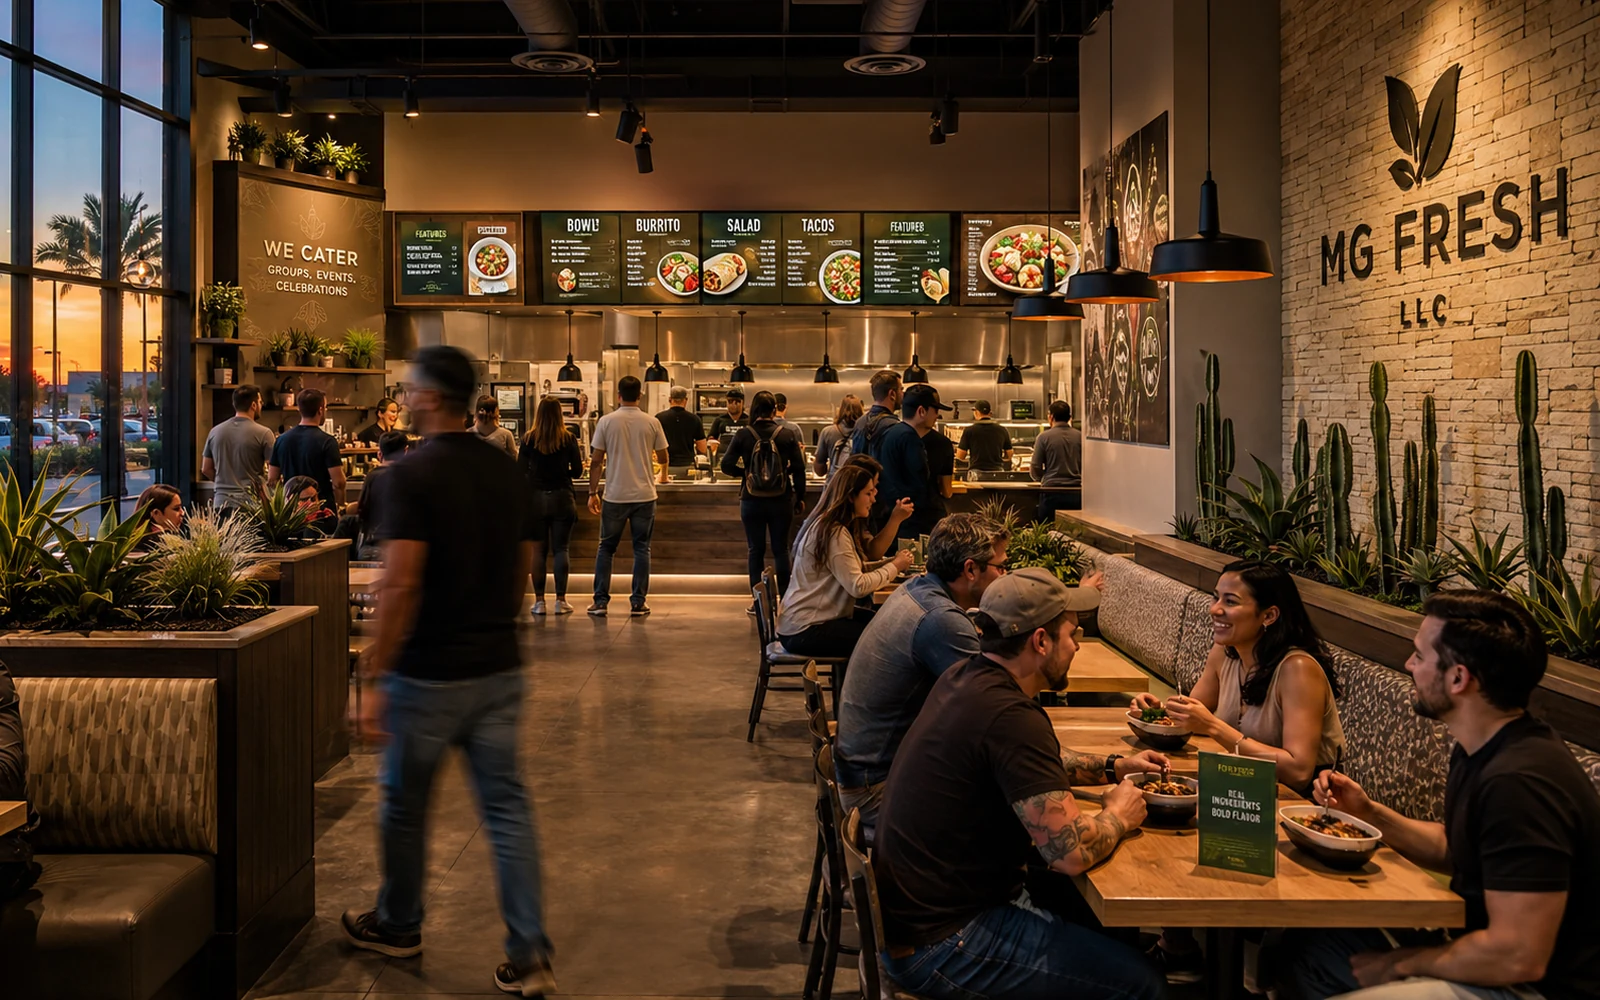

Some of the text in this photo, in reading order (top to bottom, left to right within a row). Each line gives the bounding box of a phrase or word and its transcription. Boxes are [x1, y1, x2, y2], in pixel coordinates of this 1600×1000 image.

[636, 218, 680, 232] BURRITO
[727, 218, 761, 232] SALAD
[801, 218, 835, 232] TACOS
[1321, 166, 1568, 286] MG FRESH
[264, 240, 358, 267] WE CATER
[276, 281, 348, 297] CELEBRATIONS
[1400, 294, 1447, 327] LLC
[1211, 807, 1231, 819] BOLD
